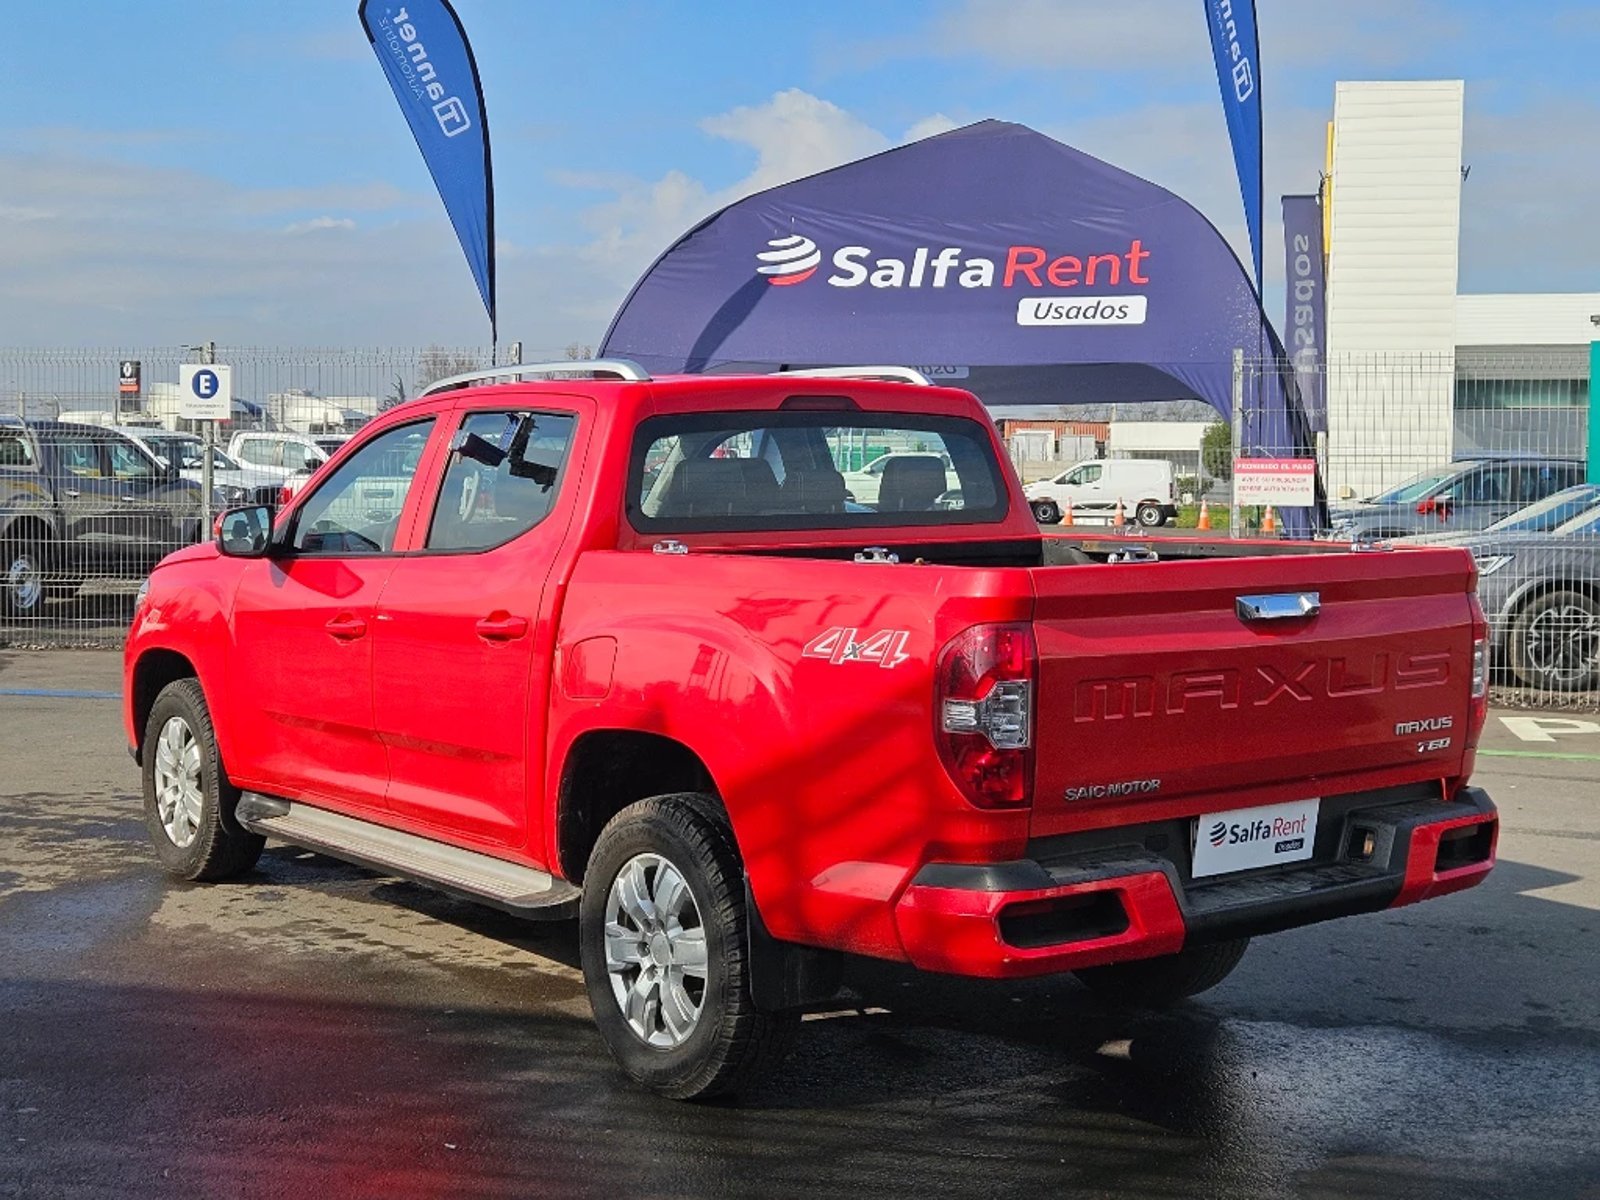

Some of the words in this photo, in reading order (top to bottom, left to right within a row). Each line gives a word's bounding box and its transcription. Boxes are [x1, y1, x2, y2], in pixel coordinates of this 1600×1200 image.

[1033, 300, 1129, 320] Usados
[199, 374, 211, 395] E
[802, 626, 910, 669] 4x4
[1074, 652, 1451, 723] MAXUS
[1396, 715, 1453, 736] MAXUS
[1064, 785, 1106, 801] SAIC
[1107, 779, 1161, 797] MOTOR
